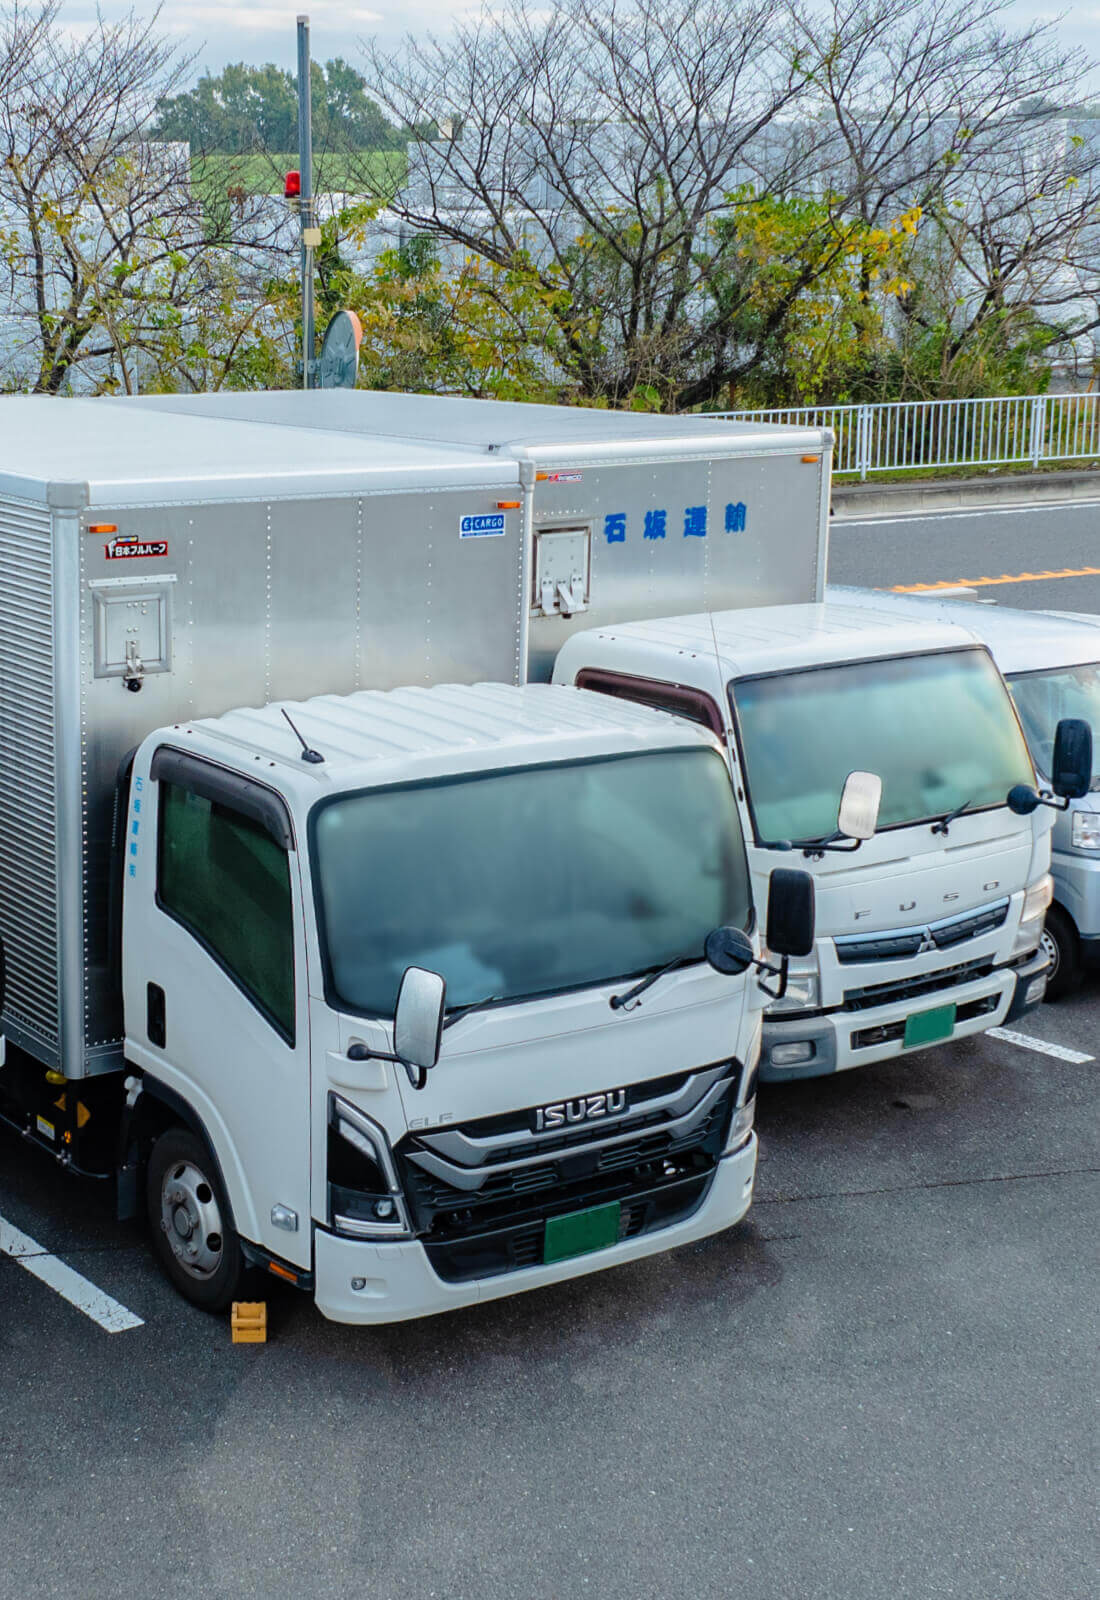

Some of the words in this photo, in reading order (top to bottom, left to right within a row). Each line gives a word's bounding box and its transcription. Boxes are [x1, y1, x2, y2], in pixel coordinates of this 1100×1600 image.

[855, 881, 999, 920] FUSO
[409, 1112, 454, 1129] ELF
[536, 1089, 626, 1130] ISUZU
